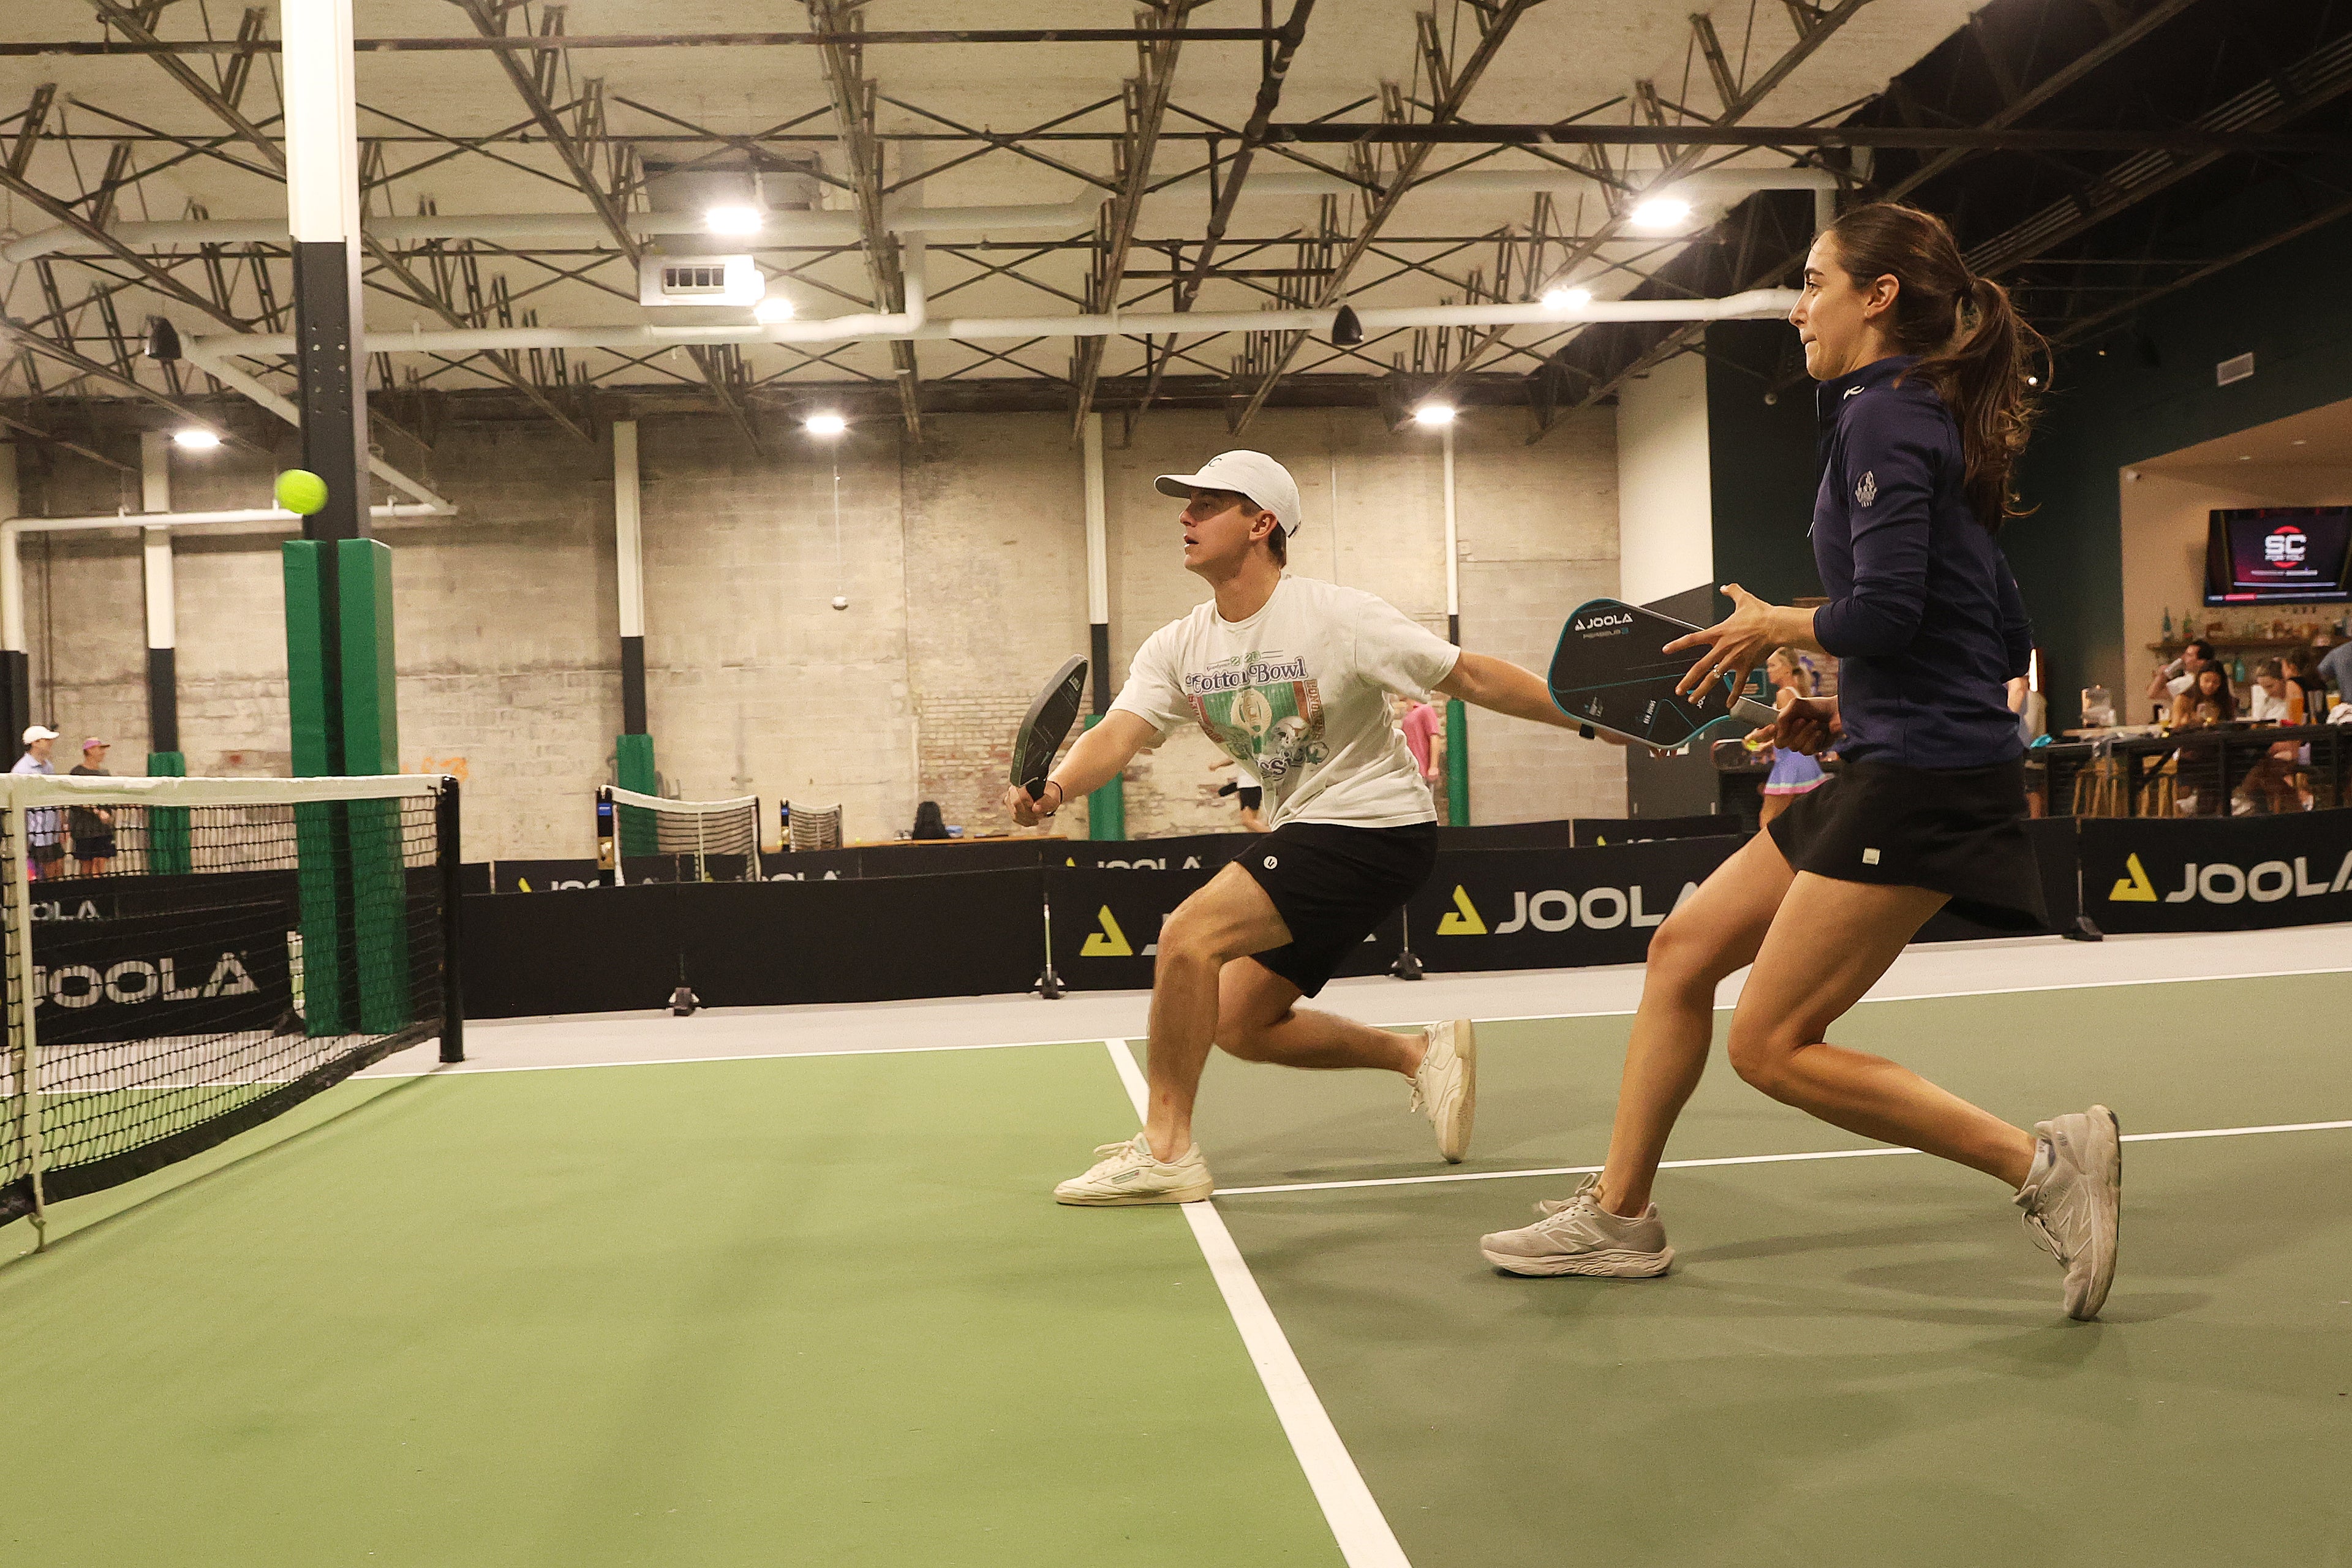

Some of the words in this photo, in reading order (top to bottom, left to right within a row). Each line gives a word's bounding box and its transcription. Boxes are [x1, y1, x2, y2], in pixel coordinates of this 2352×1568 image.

[2264, 534, 2307, 557] SC
[1586, 612, 1634, 629] JOOLA
[1248, 657, 1306, 684] Bowl
